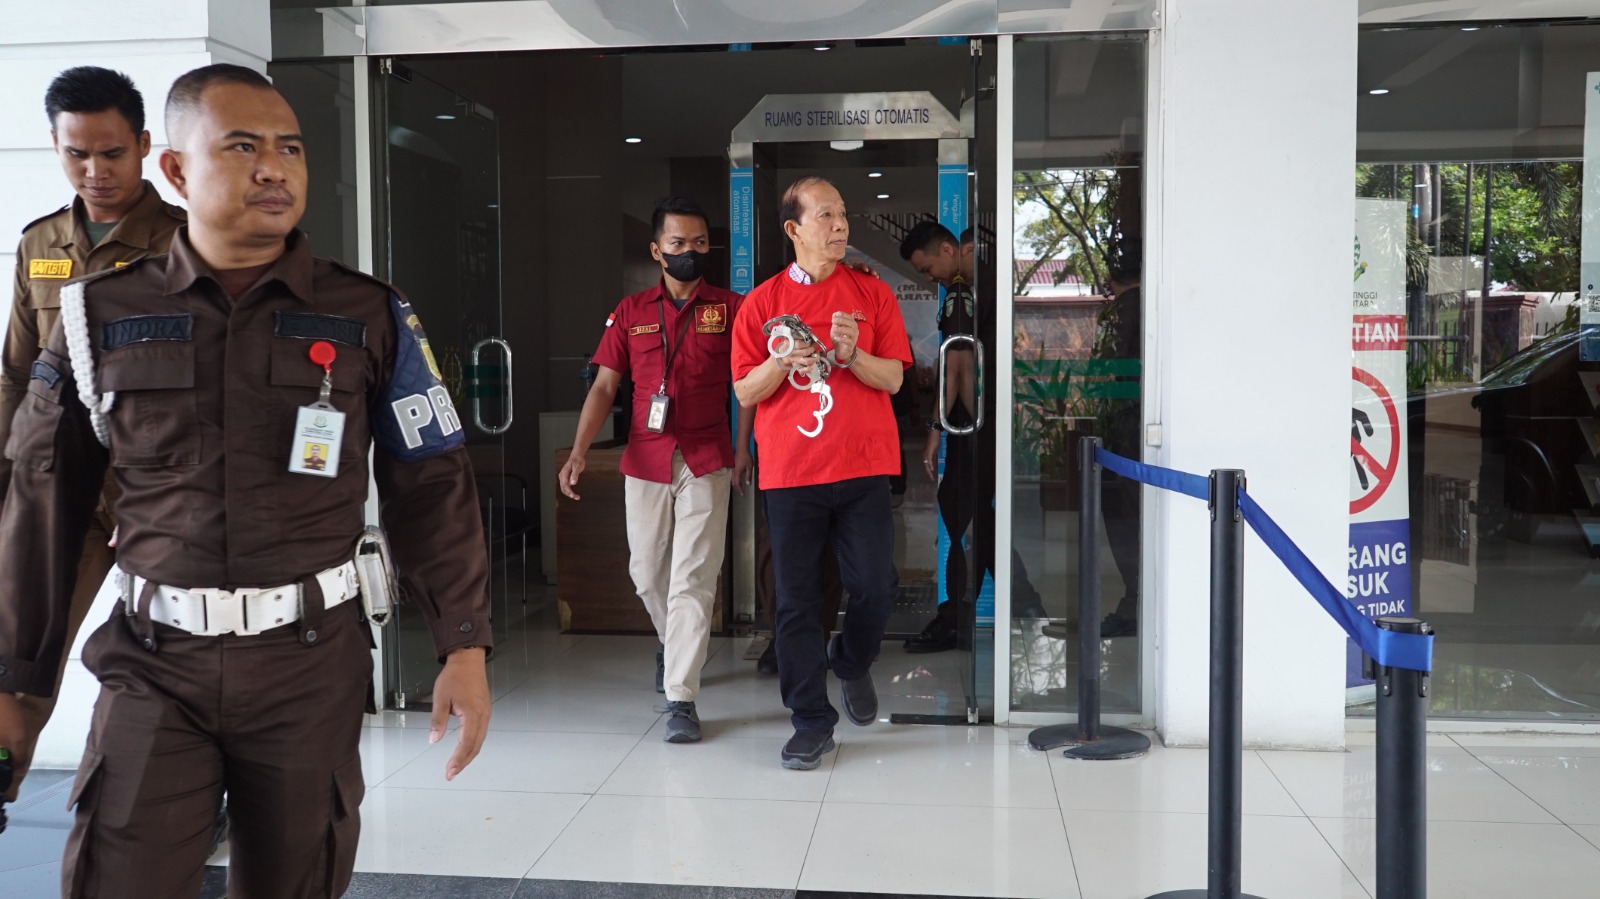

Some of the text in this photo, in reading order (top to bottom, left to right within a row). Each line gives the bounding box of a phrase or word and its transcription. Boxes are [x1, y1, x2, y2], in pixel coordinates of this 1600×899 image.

[765, 108, 930, 127] RUANG STERILISASI OTOMATIS
[742, 186, 751, 237] Disinfektan
[1353, 322, 1399, 343] TIAN
[1347, 541, 1407, 570] RANG
[1347, 571, 1390, 599] SUK
[1368, 599, 1406, 617] TIDAK
